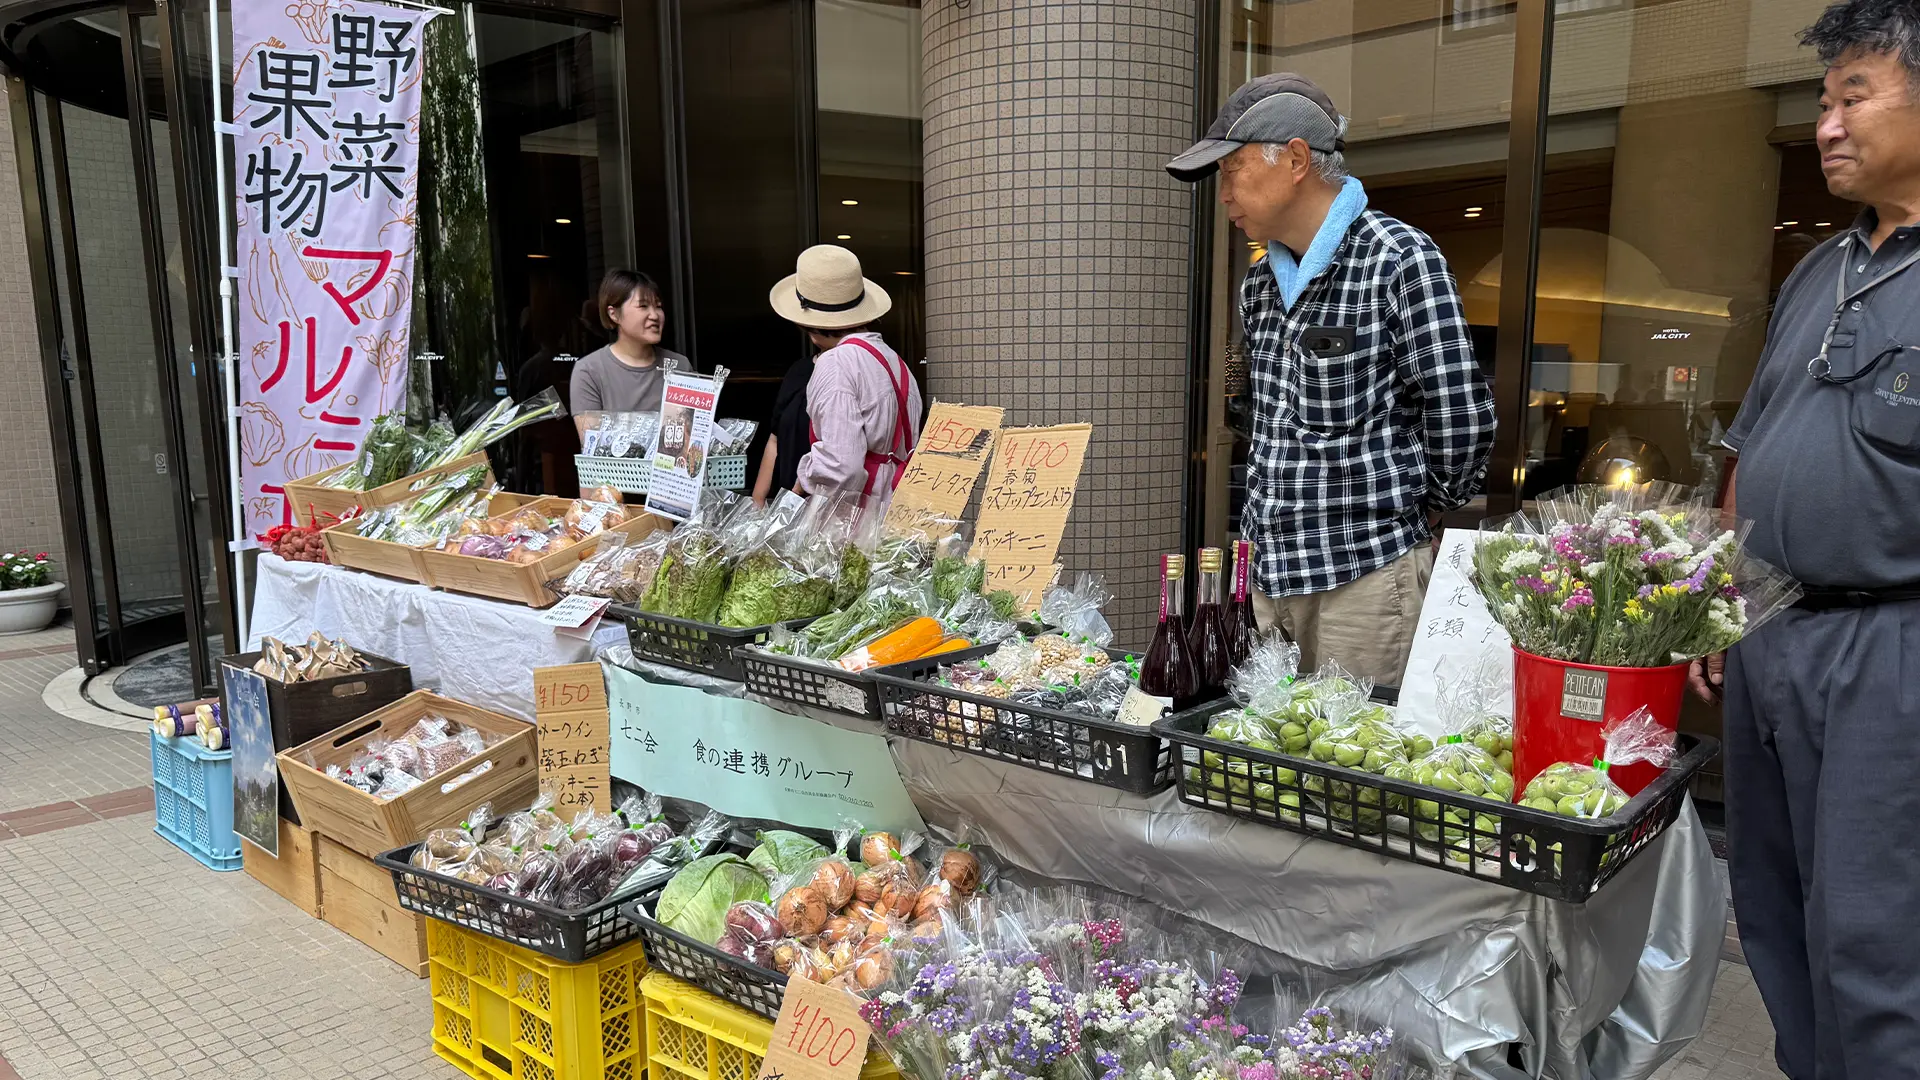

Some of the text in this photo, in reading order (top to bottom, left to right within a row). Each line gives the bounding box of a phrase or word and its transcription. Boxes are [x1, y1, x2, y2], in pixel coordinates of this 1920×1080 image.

[328, 12, 414, 200] 野菜
[245, 48, 332, 238] 果物
[1004, 437, 1069, 469] ¥100
[981, 529, 1047, 552] ズッキーニ
[539, 682, 590, 709] ¥150
[620, 718, 854, 789] 七二会 食の連携グループ
[1093, 739, 1129, 776] 01
[1508, 832, 1563, 880] 01
[788, 998, 857, 1068] ¥100
